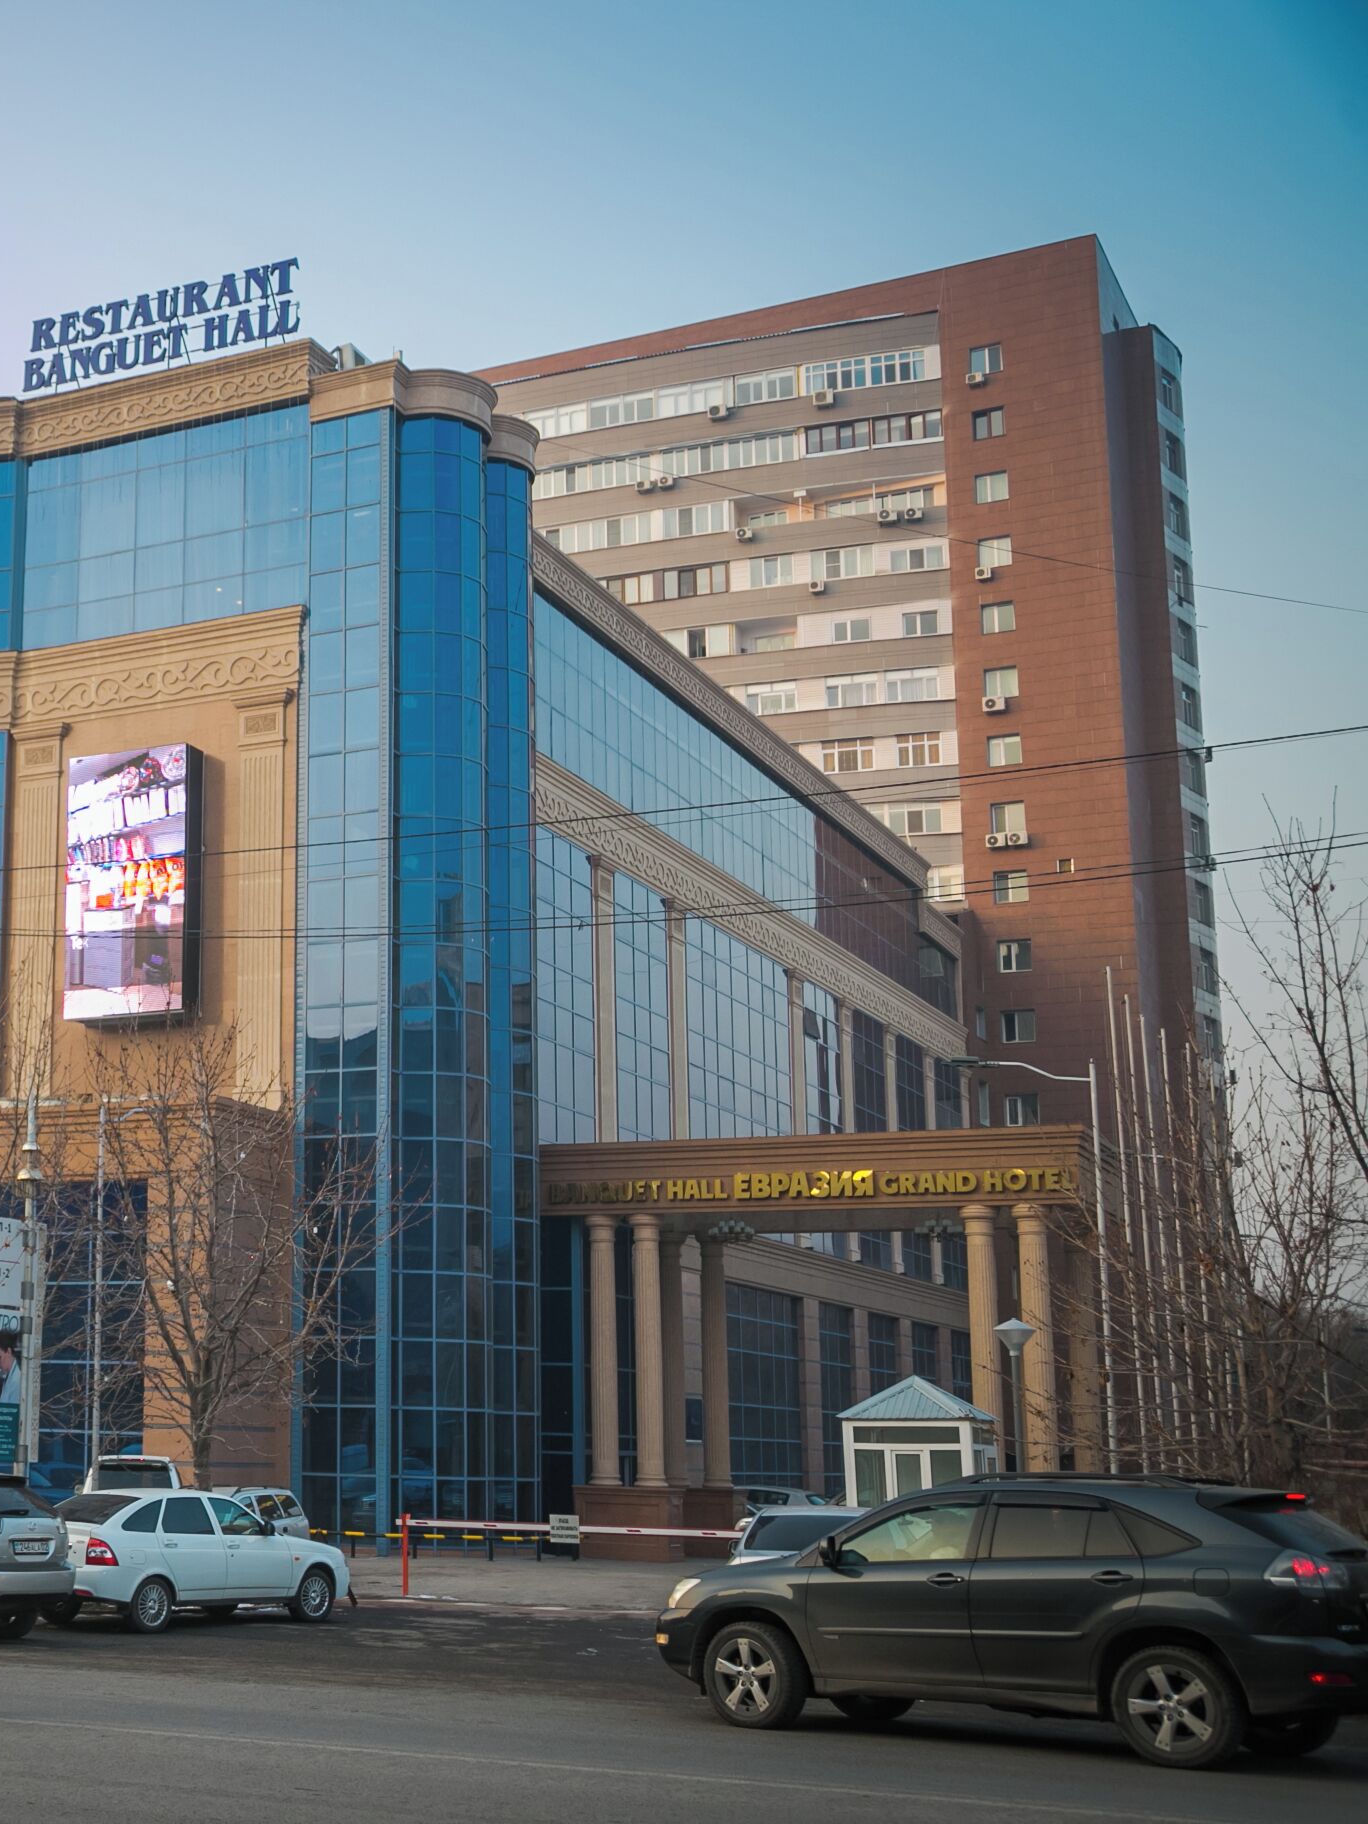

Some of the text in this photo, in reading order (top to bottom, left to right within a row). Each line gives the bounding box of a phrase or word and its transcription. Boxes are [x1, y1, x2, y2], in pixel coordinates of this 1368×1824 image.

[22, 299, 300, 392] BANGUET HALL
[30, 257, 299, 352] RESTAURANT
[667, 1178, 728, 1200] HALL
[733, 1169, 874, 1200] ЕВРАЗИЯ
[879, 1171, 978, 1195] GRAND
[983, 1168, 1076, 1192] HOTEL
